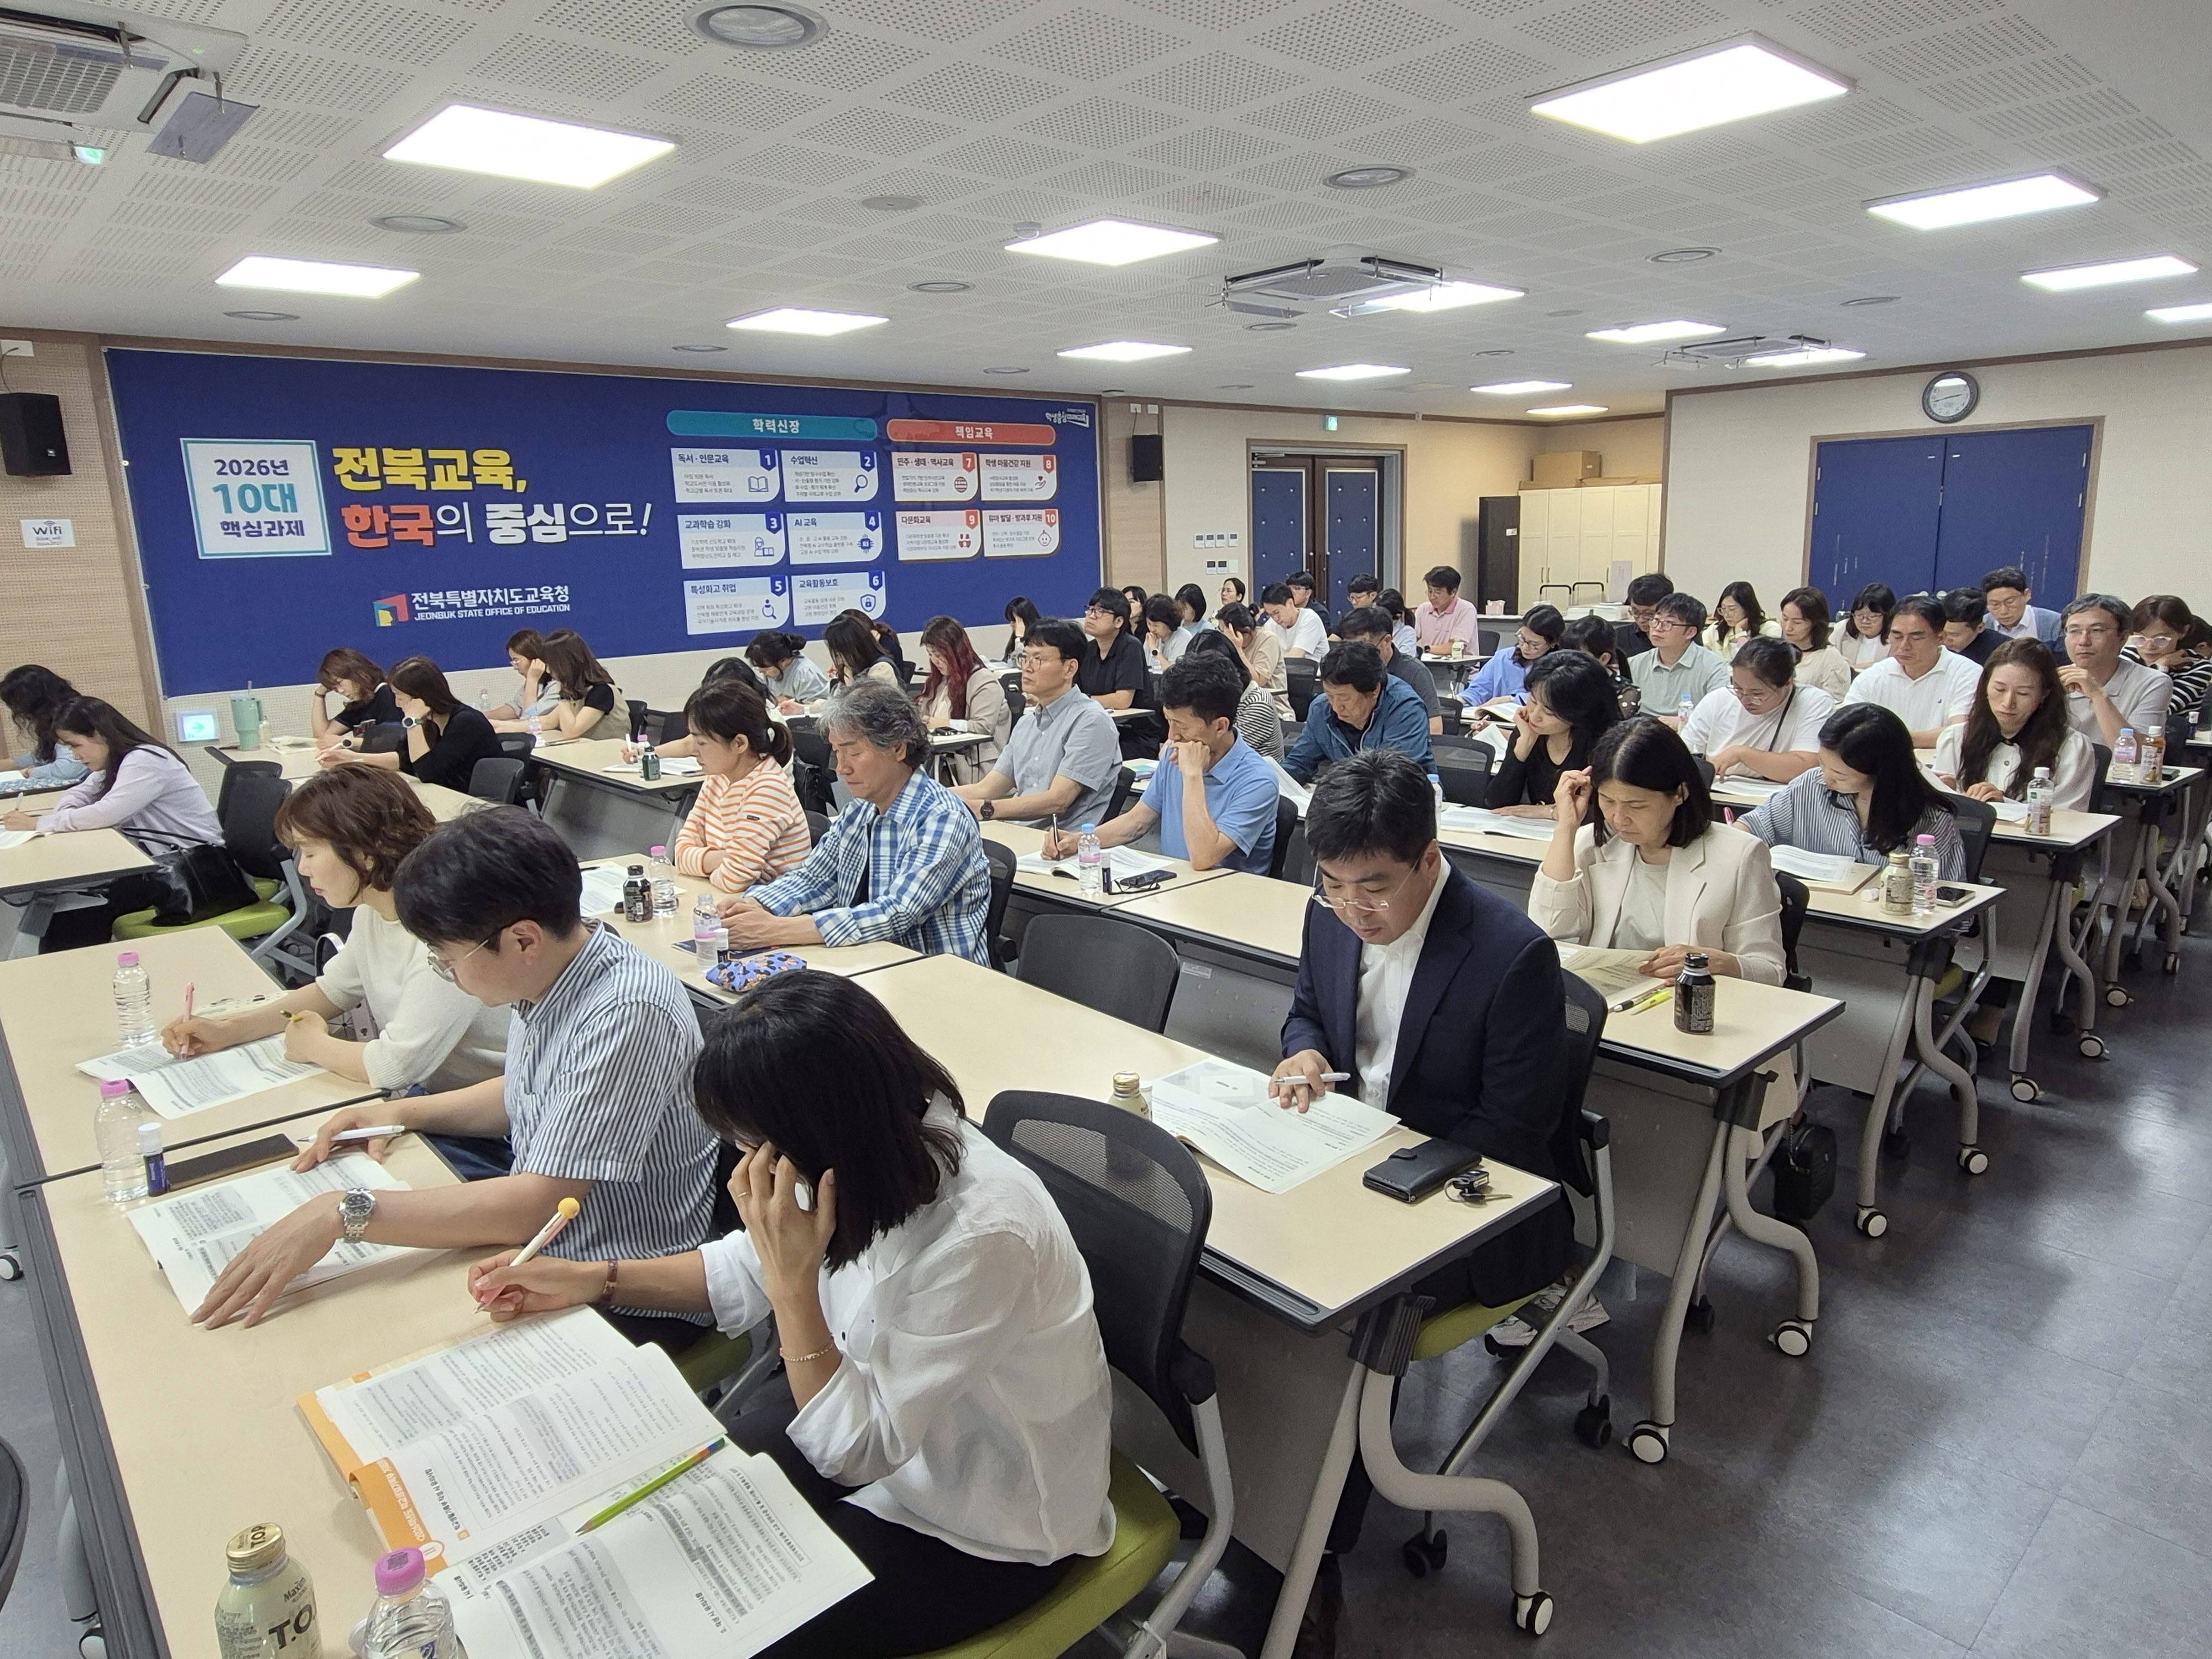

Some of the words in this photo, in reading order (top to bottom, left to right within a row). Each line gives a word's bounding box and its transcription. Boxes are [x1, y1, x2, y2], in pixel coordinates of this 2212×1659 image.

[752, 419, 800, 434] 학력신장
[955, 426, 993, 440] 책임교육
[678, 453, 693, 463] 독서
[700, 454, 729, 463] 인문교육
[765, 455, 771, 466] 1
[791, 456, 818, 465] 수업혁신
[864, 456, 871, 467] 2
[898, 458, 910, 466] 민주
[914, 458, 926, 466] 생태
[930, 458, 954, 467] 역사교육
[965, 458, 972, 468] 7
[998, 459, 1019, 467] 마음건강
[1020, 460, 1031, 468] 지원
[213, 459, 289, 476] 2026년
[332, 447, 526, 493] 전북교육,
[1046, 460, 1052, 469] 8
[212, 483, 298, 514] 10대
[341, 502, 473, 547] 한국의
[485, 503, 652, 544] 중심으로!
[685, 520, 714, 529] 교과학습
[716, 519, 731, 529] 강화
[770, 518, 778, 529] 3
[804, 518, 817, 526] 교육
[869, 516, 876, 526] 4
[901, 516, 931, 524] 다문화교육
[969, 515, 975, 524] 9
[220, 520, 305, 538] 핵심과제
[775, 581, 782, 592] 5
[799, 578, 838, 588] 교육활동보호
[873, 576, 879, 586] 6
[691, 584, 719, 594] 특성화고
[722, 583, 736, 593] 취업
[411, 585, 570, 610] 전북특별자치도교육청
[414, 610, 456, 621] JEONBUK
[457, 608, 484, 618] STATE
[485, 607, 513, 617] OFFICE
[514, 606, 525, 614] OF
[526, 604, 570, 614] EDUCATION
[283, 1577, 306, 1603] Maxim
